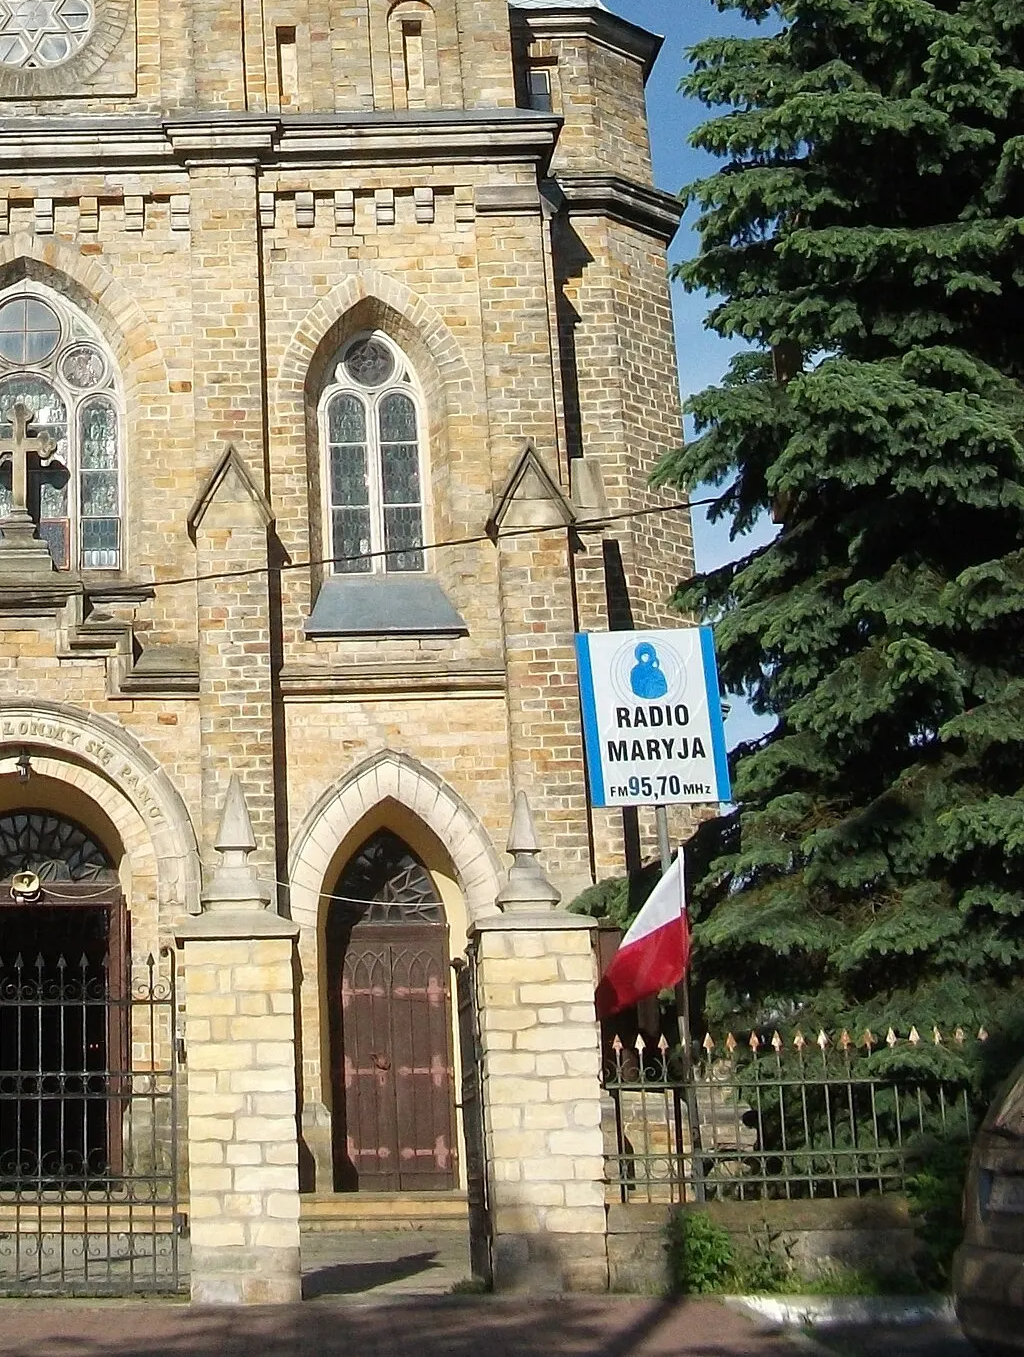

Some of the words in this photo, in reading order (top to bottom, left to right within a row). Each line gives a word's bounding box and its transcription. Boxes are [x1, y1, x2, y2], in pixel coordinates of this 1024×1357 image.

[616, 704, 690, 728] RADIO
[607, 737, 707, 762] MARYJA
[610, 786, 628, 797] FM
[628, 775, 681, 800] 95,70
[683, 783, 712, 795] MHz
